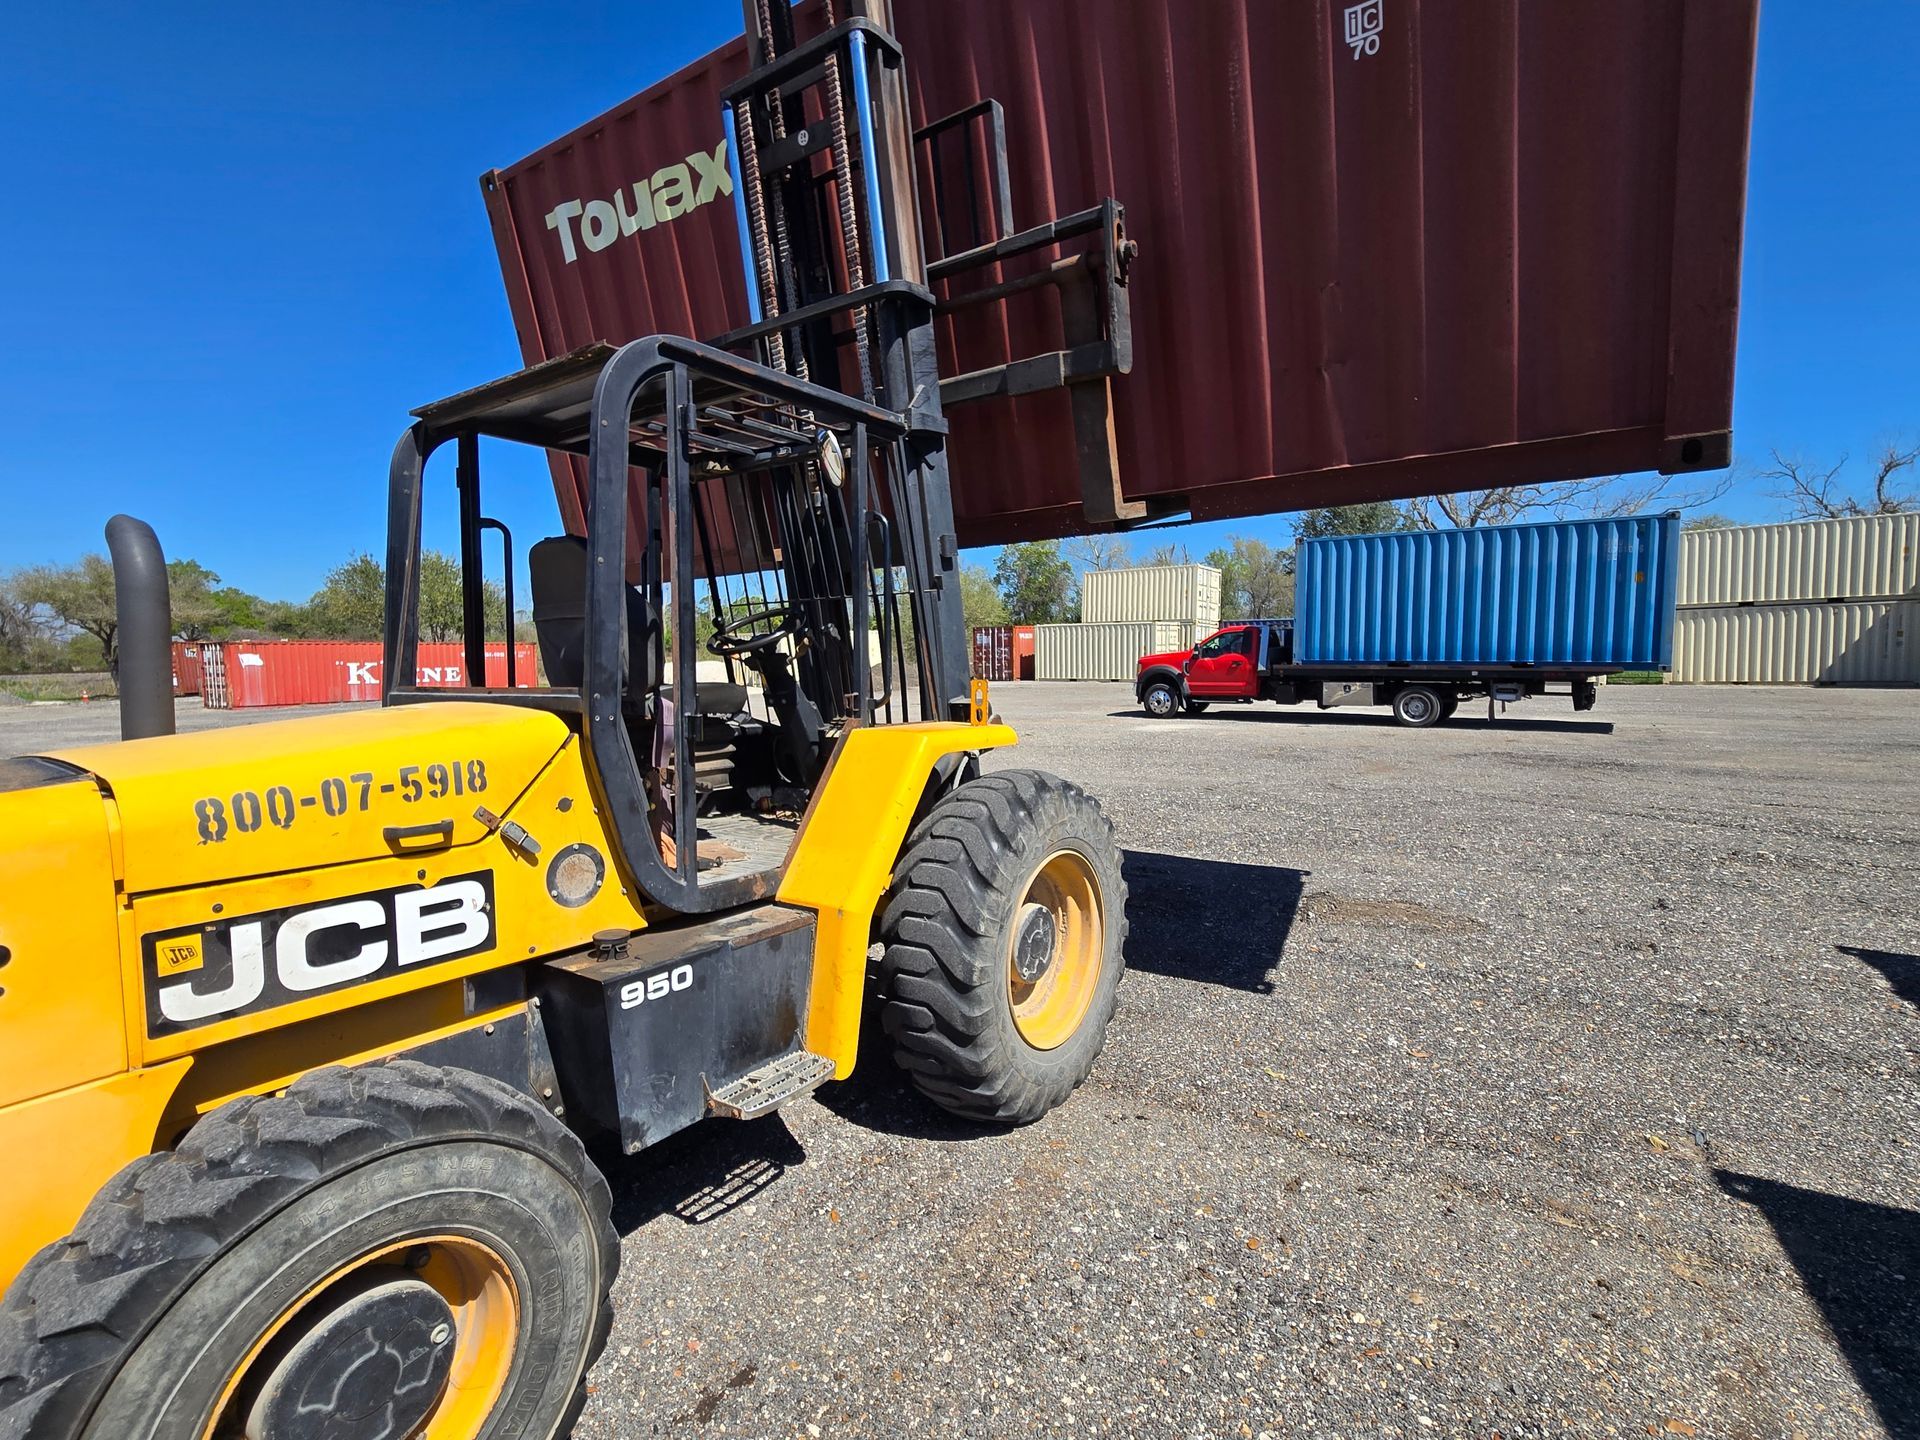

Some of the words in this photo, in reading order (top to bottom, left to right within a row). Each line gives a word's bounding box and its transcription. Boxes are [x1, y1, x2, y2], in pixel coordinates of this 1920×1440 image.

[1350, 34, 1380, 60] 70
[545, 138, 733, 264] Touax
[194, 759, 488, 845] 800-07-5918
[159, 880, 490, 1021] JCB
[169, 947, 195, 964] JCB
[620, 964, 693, 1010] 950
[540, 1268, 562, 1335] RIM
